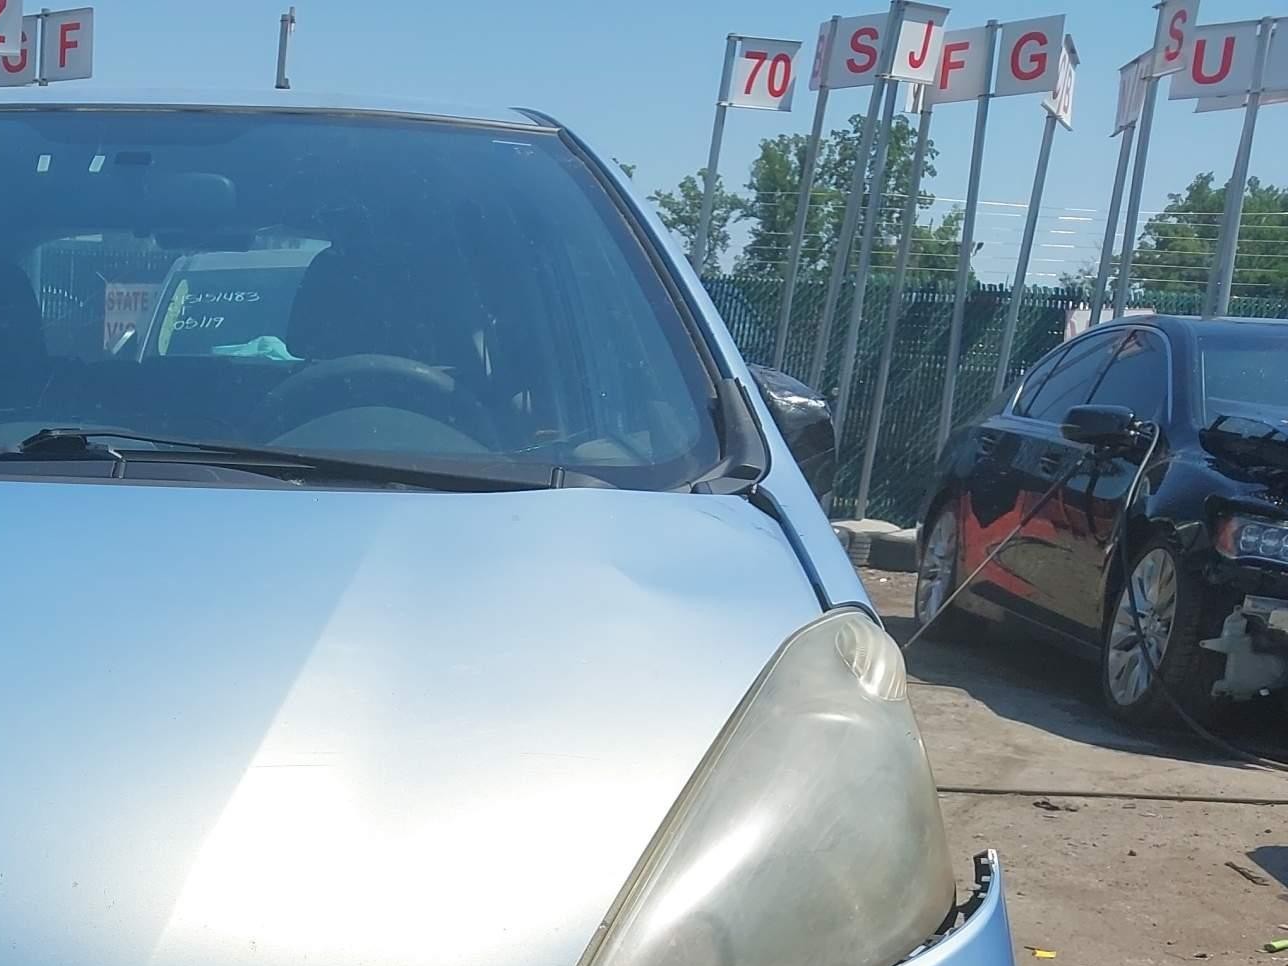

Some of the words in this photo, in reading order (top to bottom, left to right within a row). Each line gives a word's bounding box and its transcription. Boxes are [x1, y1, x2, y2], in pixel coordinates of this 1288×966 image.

[59, 22, 81, 67] F
[846, 27, 879, 73] S
[908, 20, 934, 69] J
[1011, 31, 1048, 80] G
[1165, 9, 1187, 61] S
[744, 51, 792, 98] 70
[939, 41, 969, 90] F
[1192, 36, 1235, 84] U
[107, 291, 149, 312] STATE
